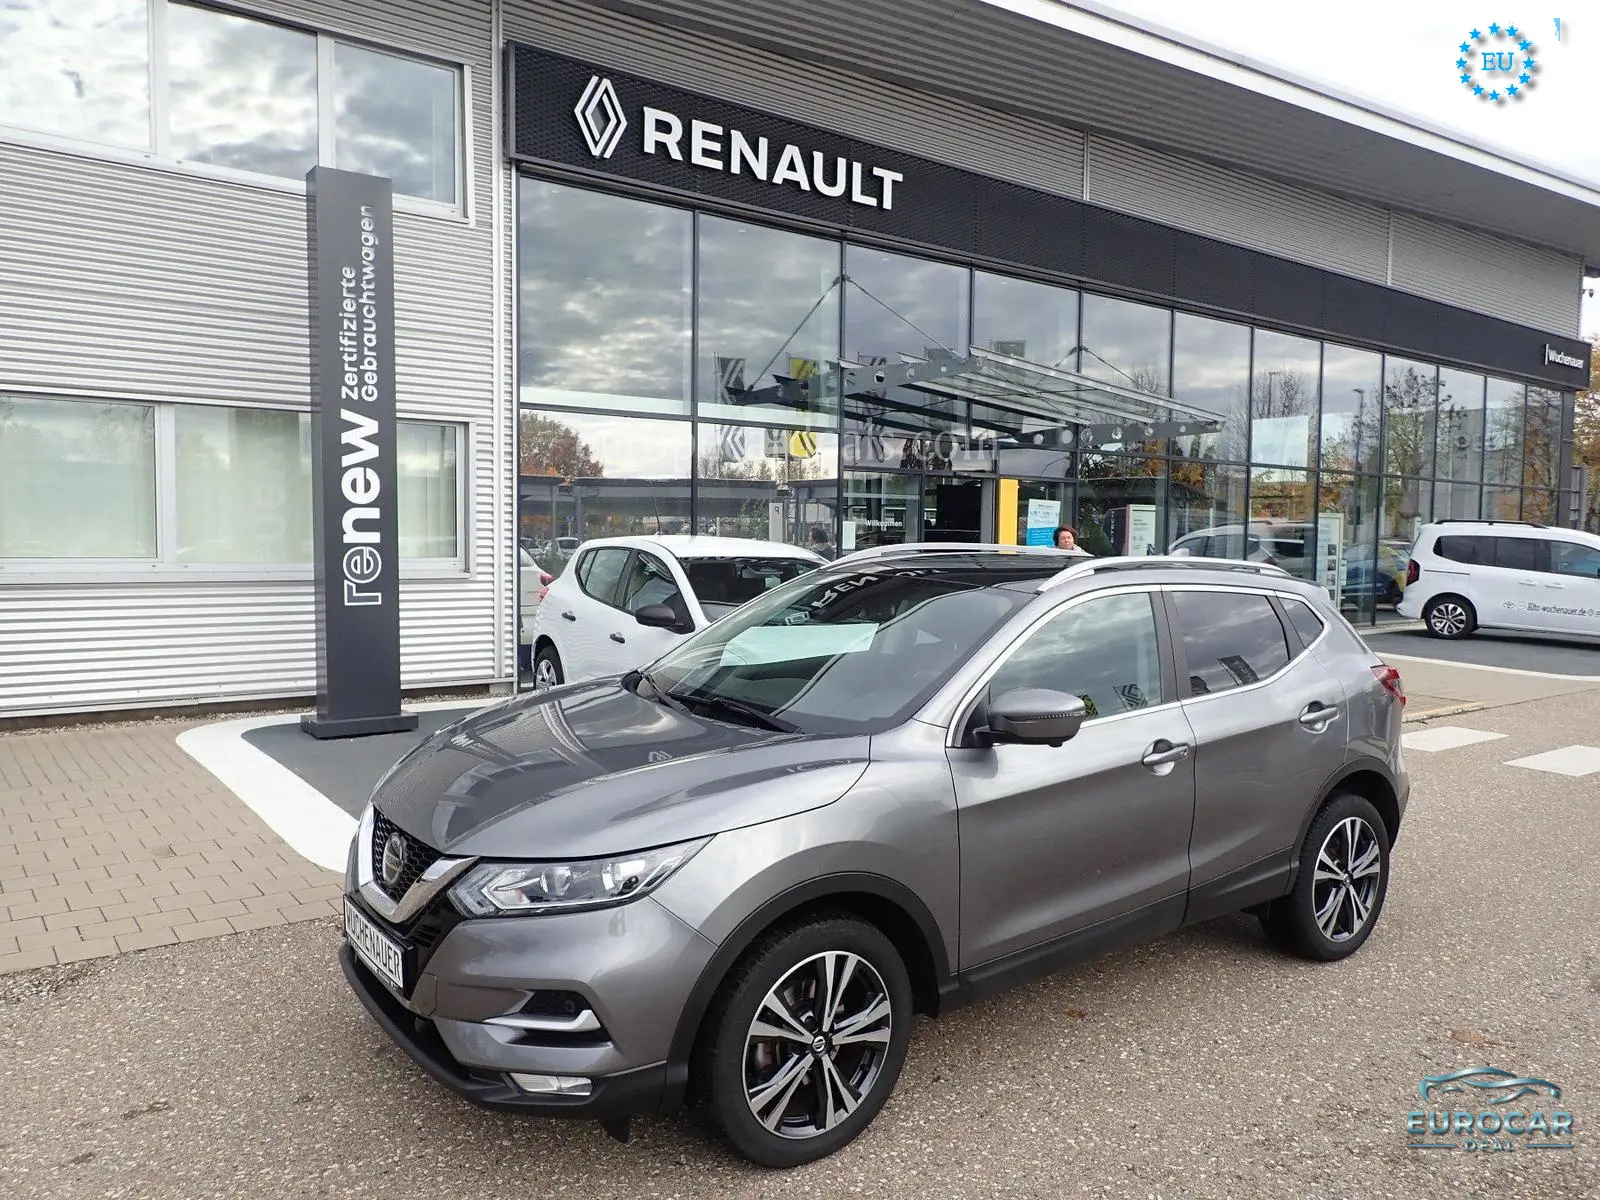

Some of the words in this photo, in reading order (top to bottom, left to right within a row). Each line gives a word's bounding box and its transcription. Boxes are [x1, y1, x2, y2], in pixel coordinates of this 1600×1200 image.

[643, 106, 904, 210] RENAULT
[339, 265, 360, 401] Zertifizierte
[360, 204, 380, 403] Gebrauchtwagen
[1548, 349, 1585, 369] Wuchenauer
[340, 408, 382, 606] renew
[345, 901, 402, 981] WUCHENAUER
